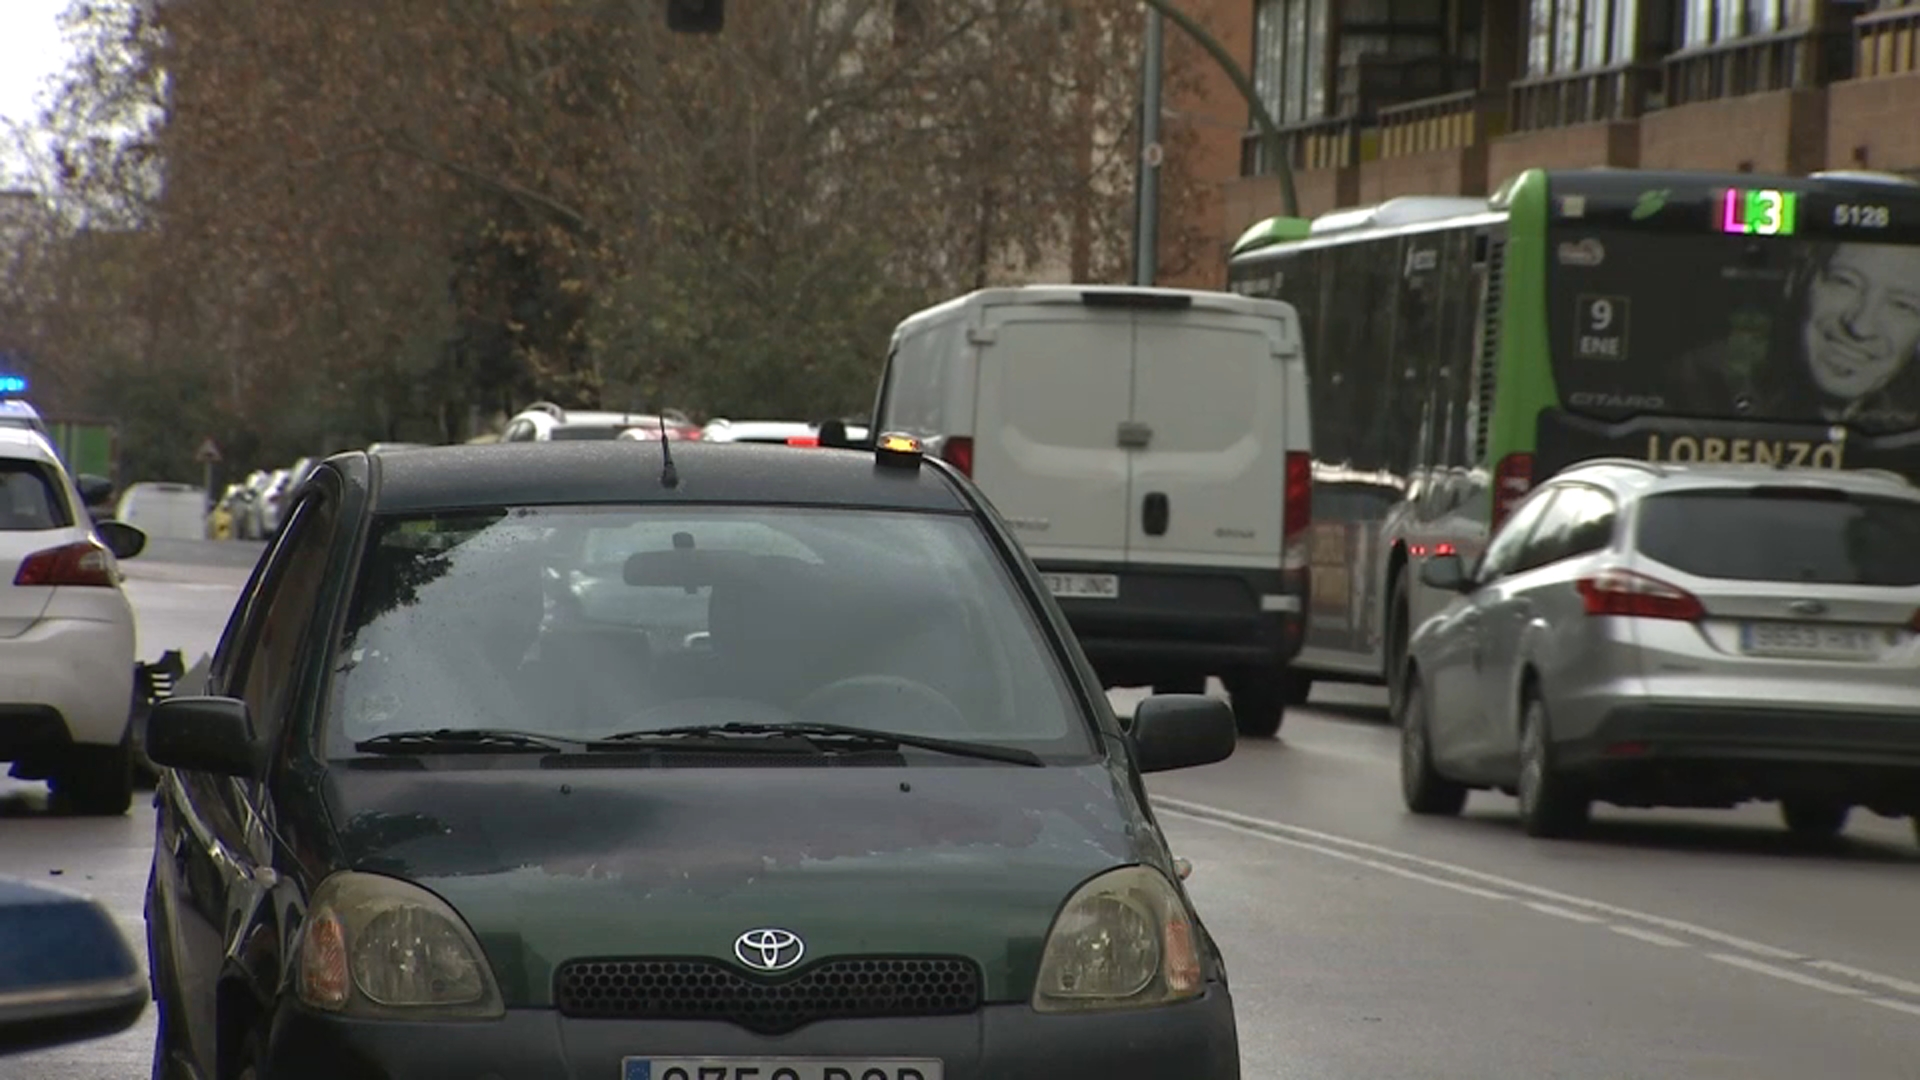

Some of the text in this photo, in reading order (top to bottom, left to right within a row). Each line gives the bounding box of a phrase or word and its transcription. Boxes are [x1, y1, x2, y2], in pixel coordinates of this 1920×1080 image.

[1834, 204, 1889, 228] 5128
[1590, 299, 1613, 330] 9
[1579, 336, 1620, 356] ENE
[1648, 433, 1845, 470] LORENZO
